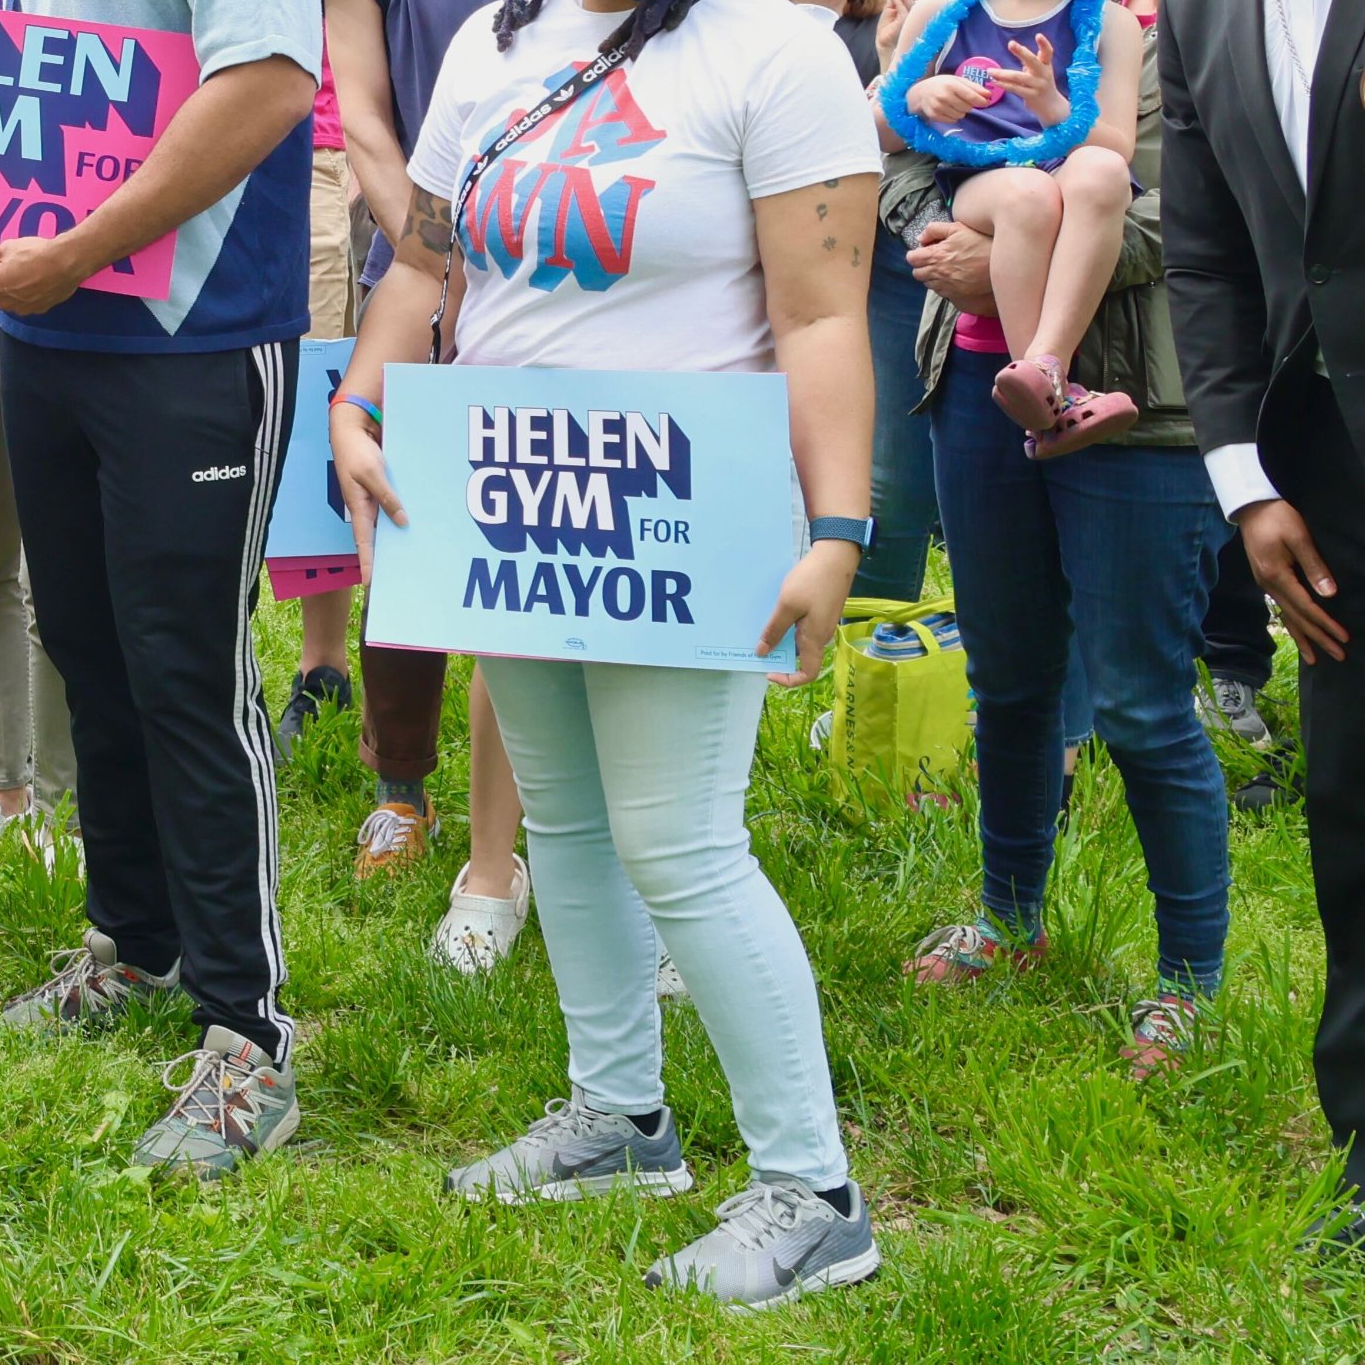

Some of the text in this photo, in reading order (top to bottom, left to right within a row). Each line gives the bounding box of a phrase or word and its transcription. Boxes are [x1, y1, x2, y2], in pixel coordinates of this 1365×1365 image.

[495, 104, 552, 151] adidas
[468, 405, 670, 470] HELEN
[192, 466, 246, 482] adidas
[467, 467, 690, 544] GYM FOR
[463, 558, 694, 624] MAYOR
[845, 664, 855, 737] BARNES
